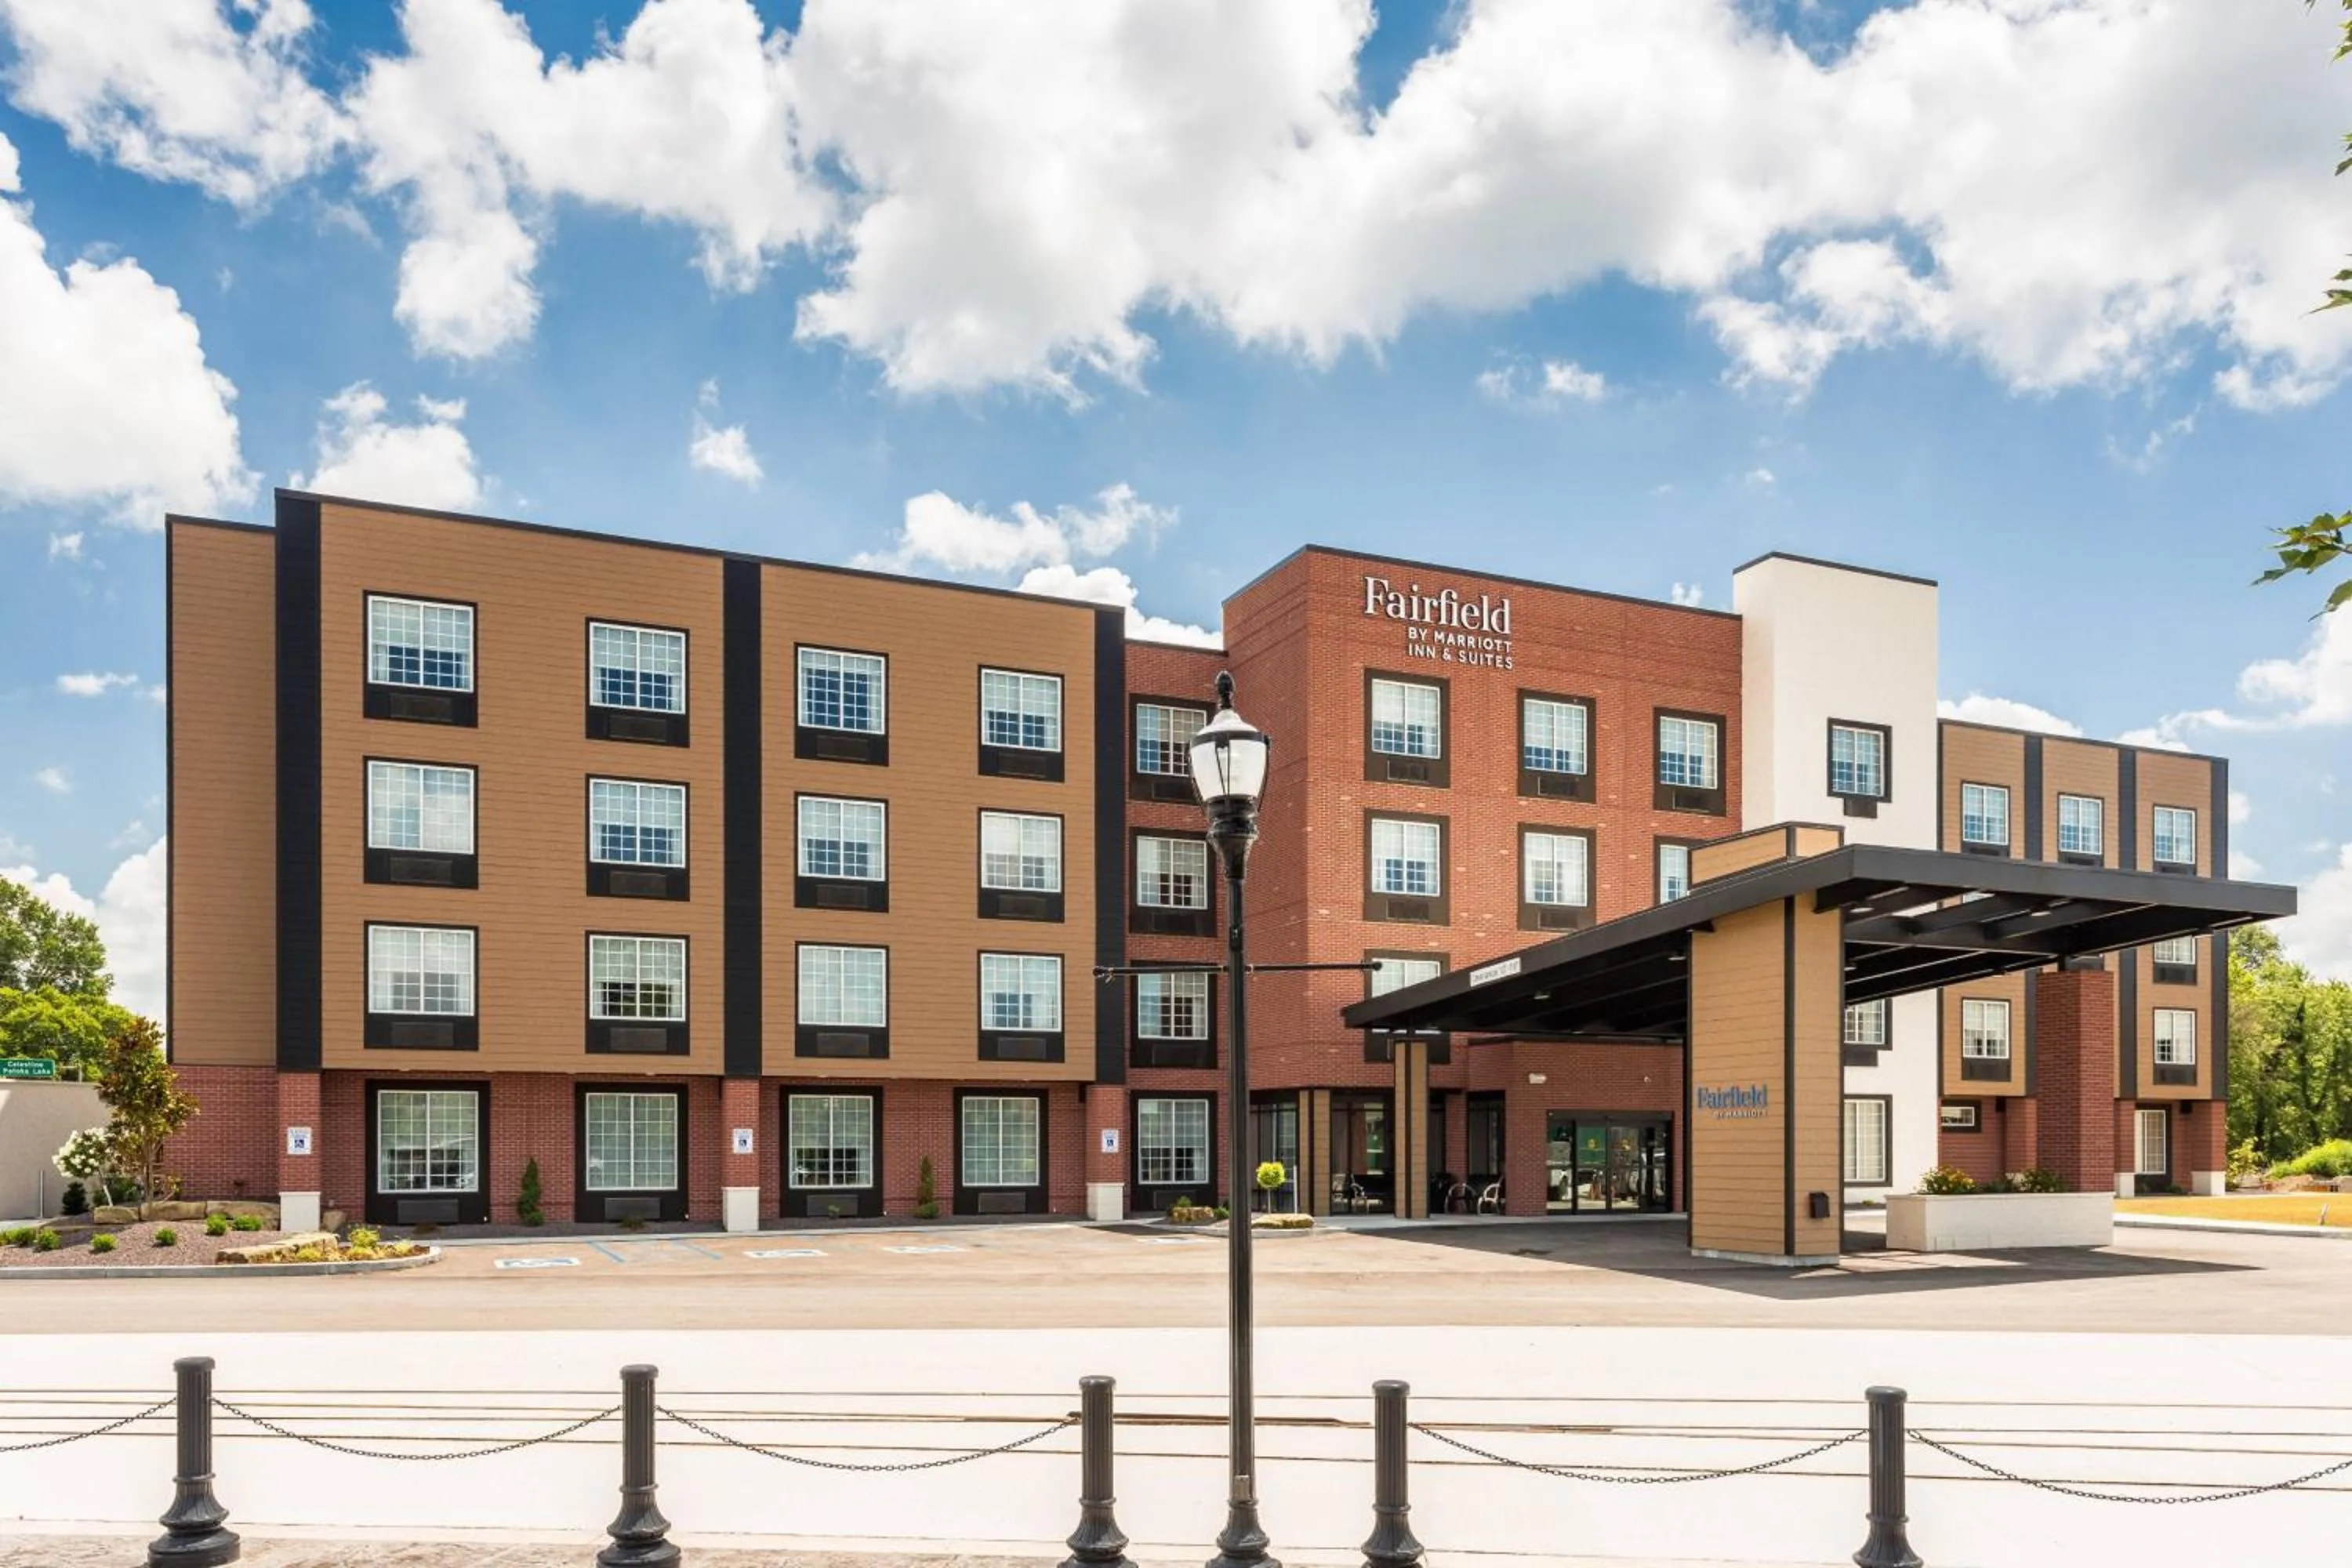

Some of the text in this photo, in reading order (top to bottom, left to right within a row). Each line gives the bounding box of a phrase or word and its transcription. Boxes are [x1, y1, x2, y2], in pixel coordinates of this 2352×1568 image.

[1364, 576, 1511, 634] Fairfield
[1408, 626, 1512, 653] BY MARRIOTT
[1408, 644, 1512, 670] INN & SUITES
[1697, 1083, 1767, 1109] Fairfield
